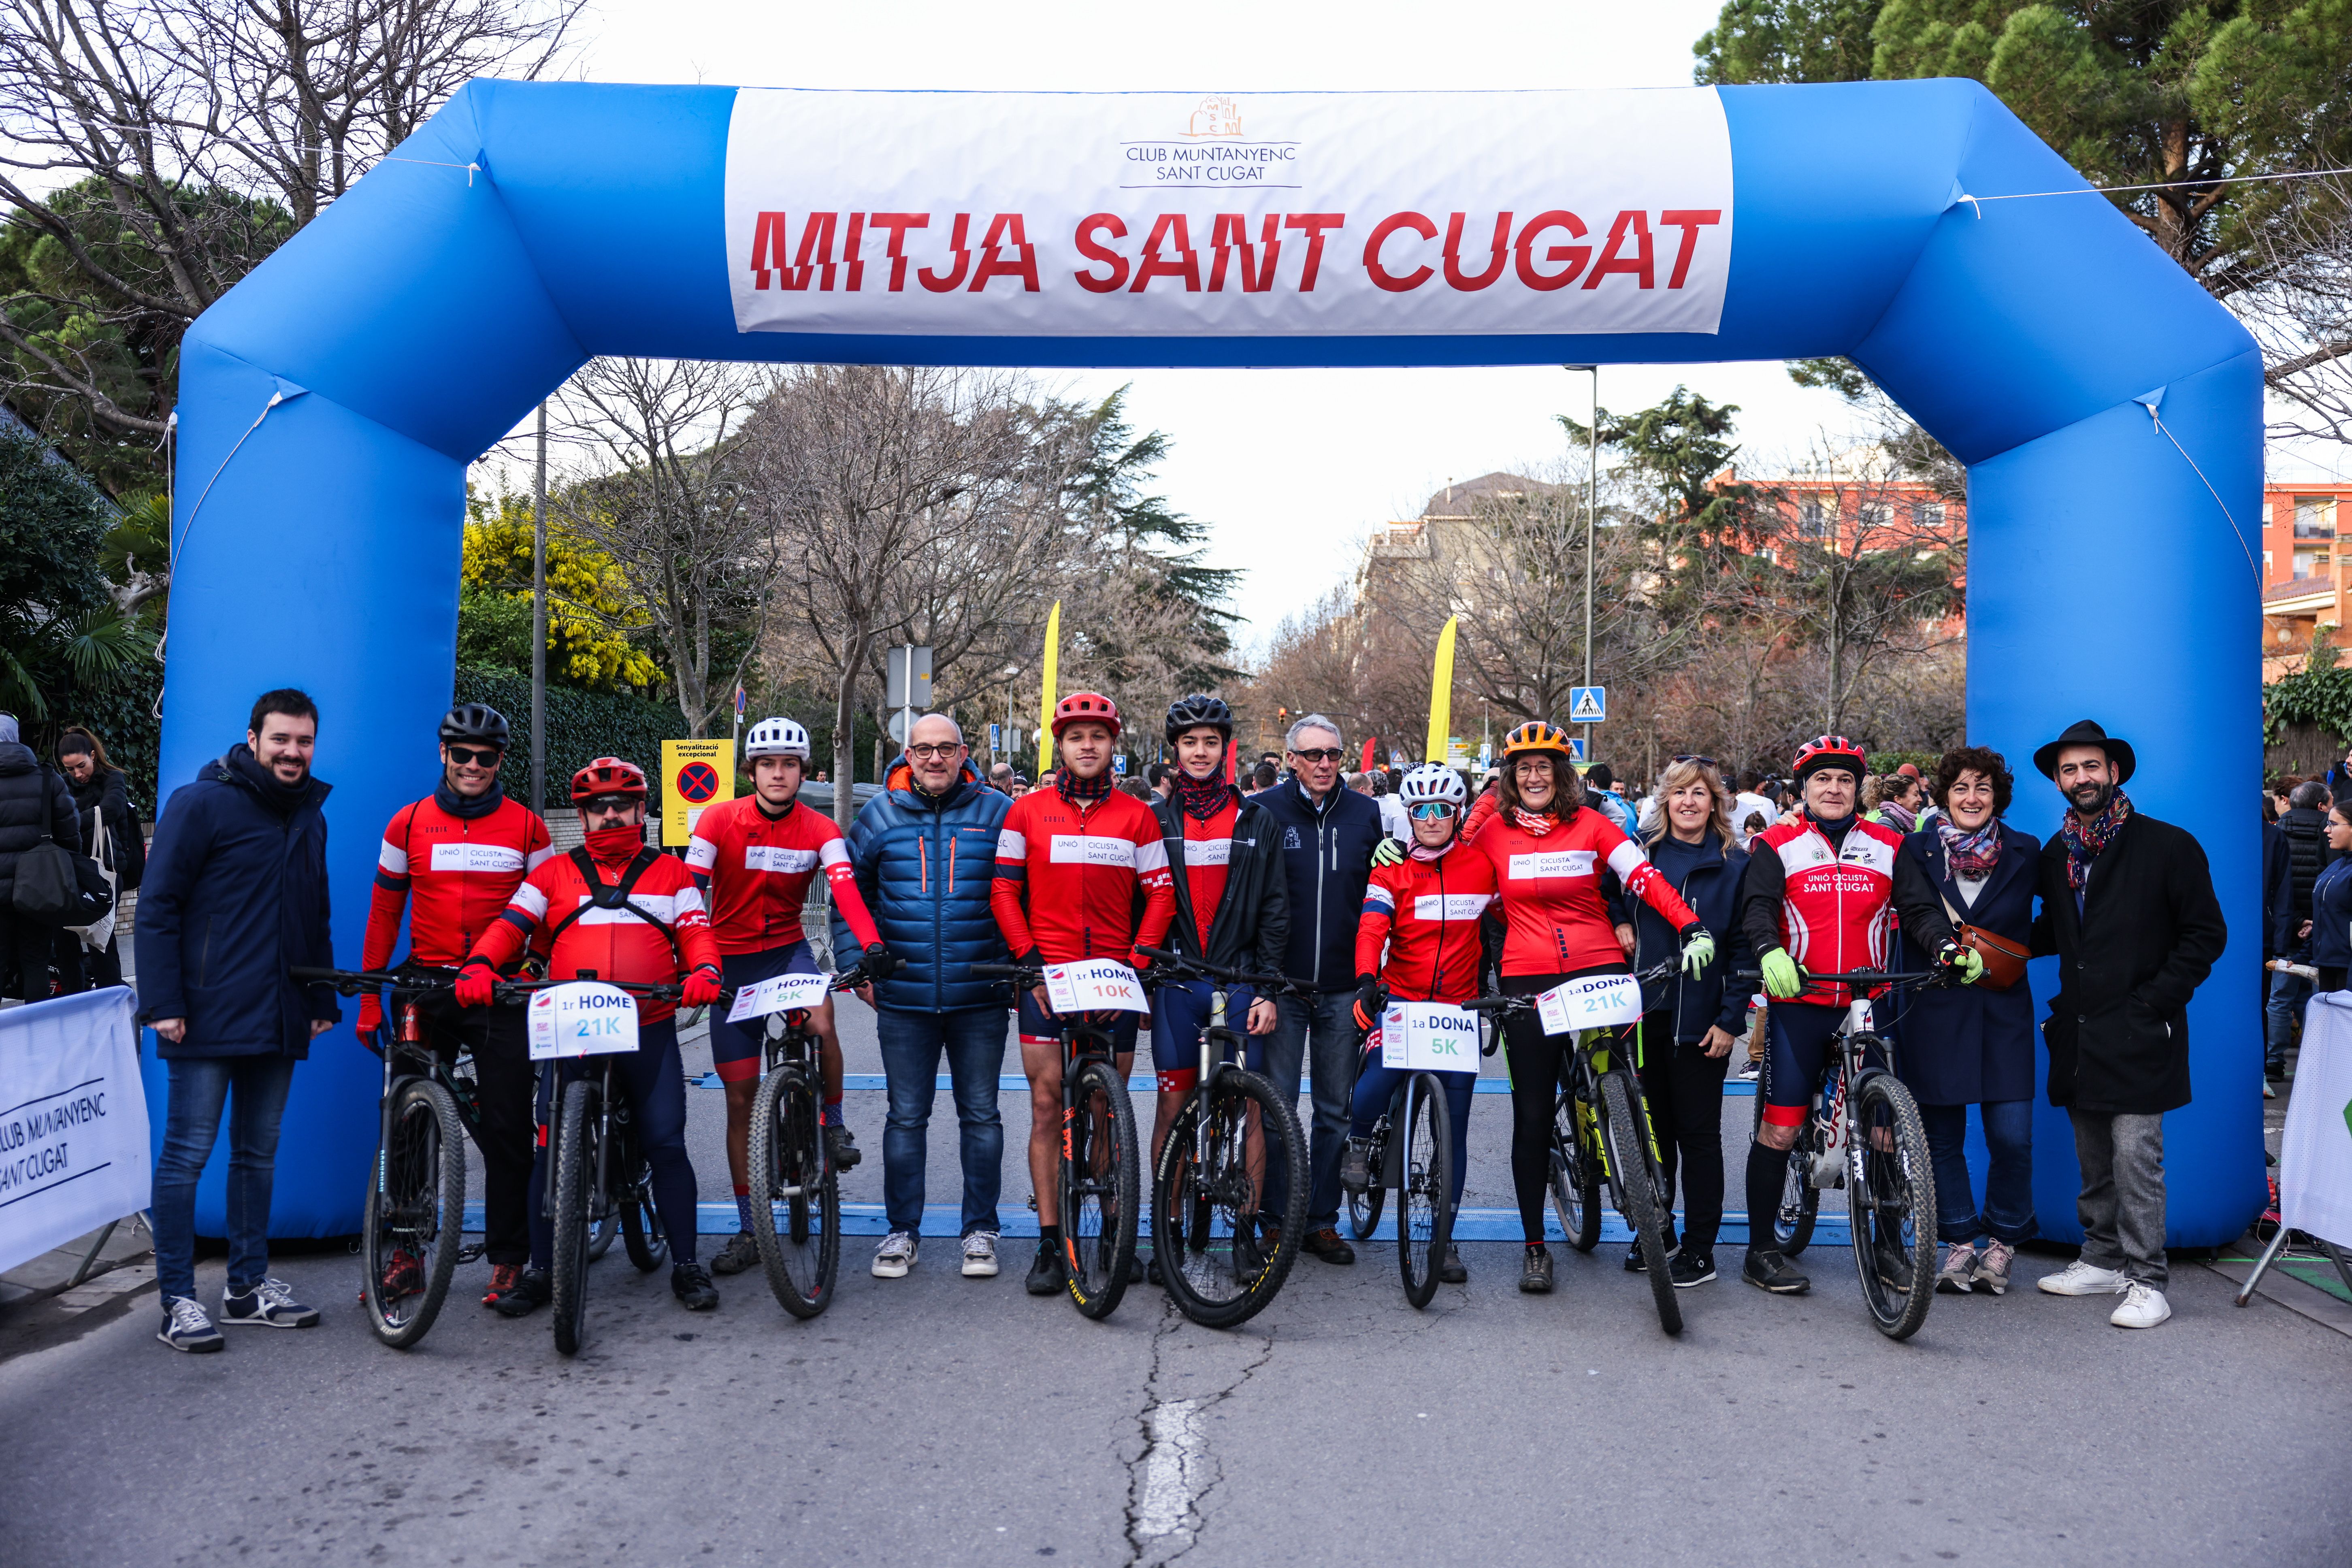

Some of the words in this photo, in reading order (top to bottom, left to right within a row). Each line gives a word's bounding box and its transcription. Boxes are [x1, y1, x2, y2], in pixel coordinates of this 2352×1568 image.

[1126, 147, 1167, 162] CLUB
[1173, 147, 1295, 162] MUNTANYENC
[1157, 166, 1202, 180] SANT
[1207, 166, 1265, 181] CUGAT
[750, 211, 1040, 292] MITJA
[1075, 213, 1344, 293] SANT
[1363, 209, 1721, 292] CUGAT
[470, 850, 502, 858] CICLISTA
[688, 846, 704, 858] CSC
[1088, 842, 1119, 851] CICLISTA
[774, 853, 798, 861] CICLISTA
[1109, 854, 1130, 862] CUGAT
[1808, 873, 1830, 882] UNIÓ
[1804, 883, 1832, 893] SANT
[1835, 882, 1874, 893] CUGAT
[1367, 892, 1384, 900] CSC
[1090, 968, 1136, 983] HOME
[777, 979, 825, 990] HOME
[1093, 984, 1133, 999] 10K
[1582, 977, 1632, 993] DONA
[562, 1001, 574, 1010] 1r
[579, 995, 631, 1009] HOME
[776, 990, 805, 1003] 5K
[1584, 991, 1628, 1013] 21K
[576, 1016, 621, 1037] 21K
[1412, 1020, 1425, 1028] 1a
[1429, 1015, 1475, 1032] DONA
[1432, 1038, 1459, 1056] 5K
[1827, 1070, 1845, 1148] ORBE
[0, 1122, 24, 1153] LUB
[26, 1092, 106, 1144] MUNTANYENC
[0, 1159, 26, 1193] ANT
[26, 1142, 68, 1180] CUGAT
[1851, 1149, 1864, 1182] FOX
